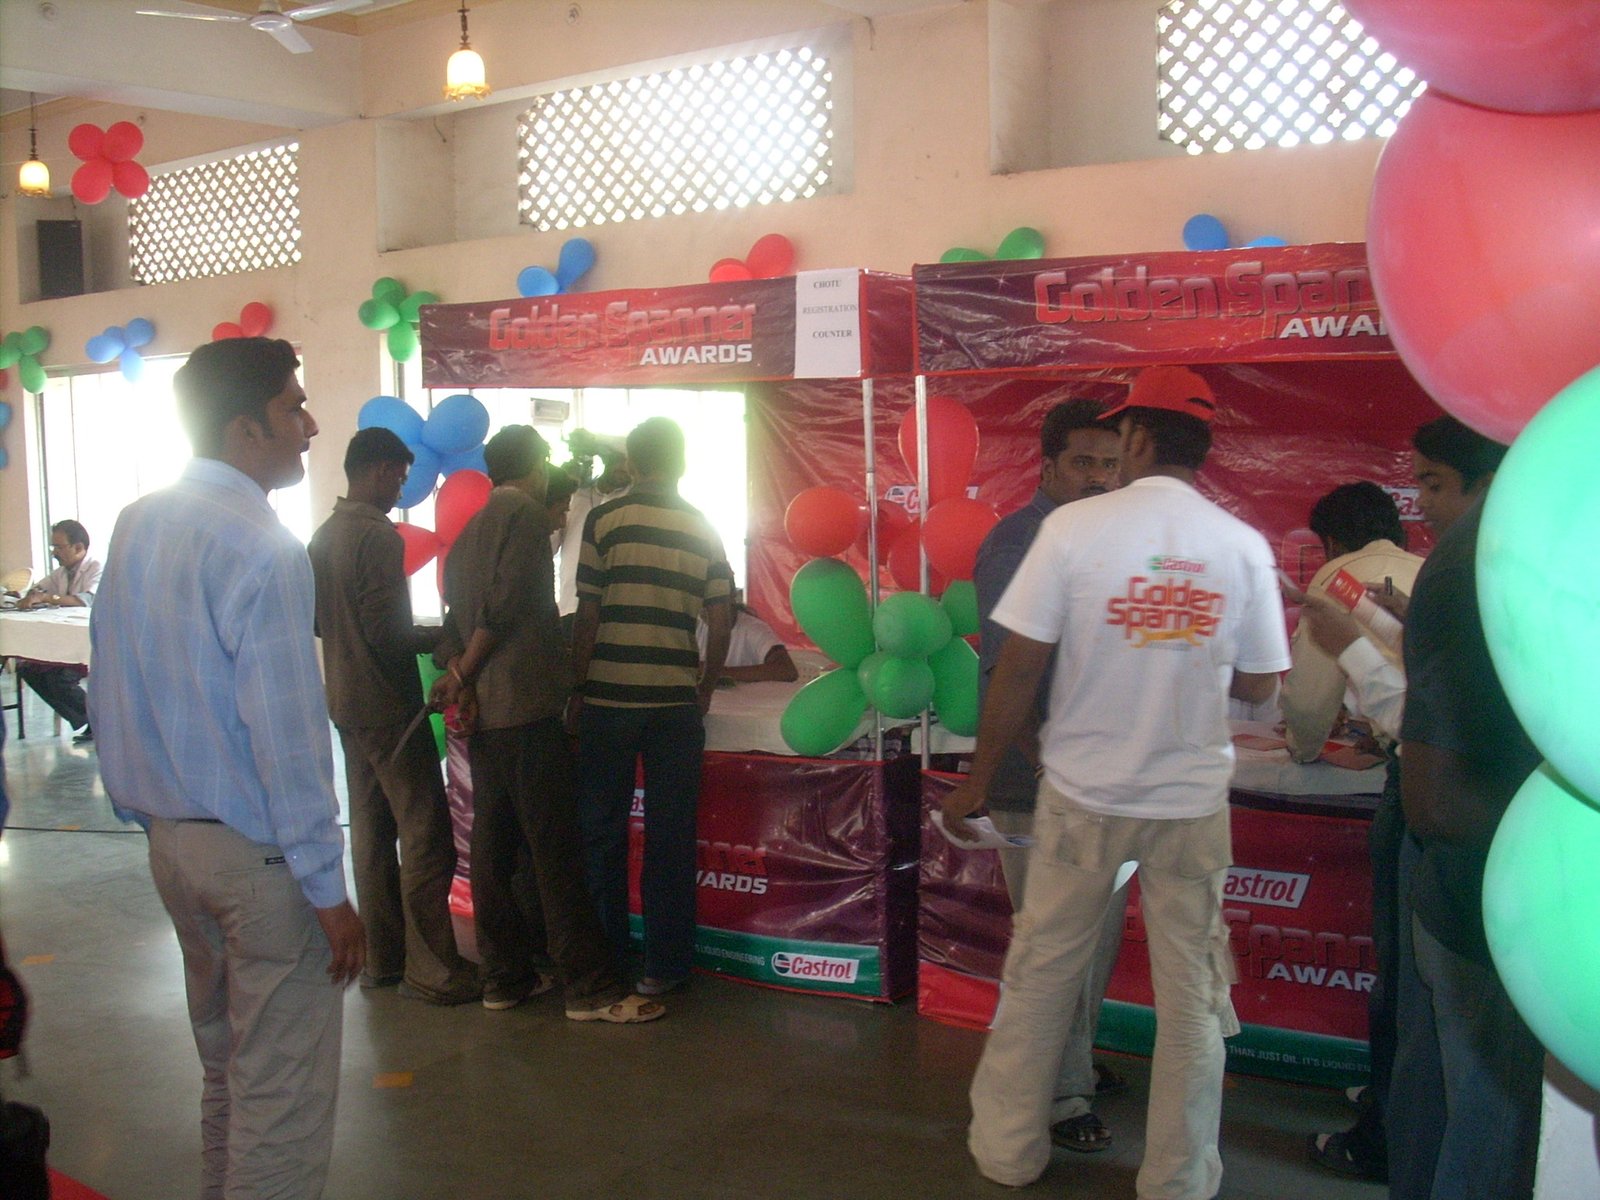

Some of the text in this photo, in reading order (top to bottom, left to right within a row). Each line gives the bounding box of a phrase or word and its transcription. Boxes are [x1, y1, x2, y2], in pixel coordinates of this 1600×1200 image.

[1034, 265, 1218, 324] Golden
[803, 304, 857, 314] REGISTRATION
[489, 301, 756, 366] Golden Spanner
[812, 330, 852, 339] COUNTER
[640, 344, 753, 366] AWARDS
[1128, 576, 1225, 615] Golden
[1106, 598, 1221, 640] Spanner
[791, 956, 852, 979] Castrol
[1257, 1050, 1280, 1062] JUST
